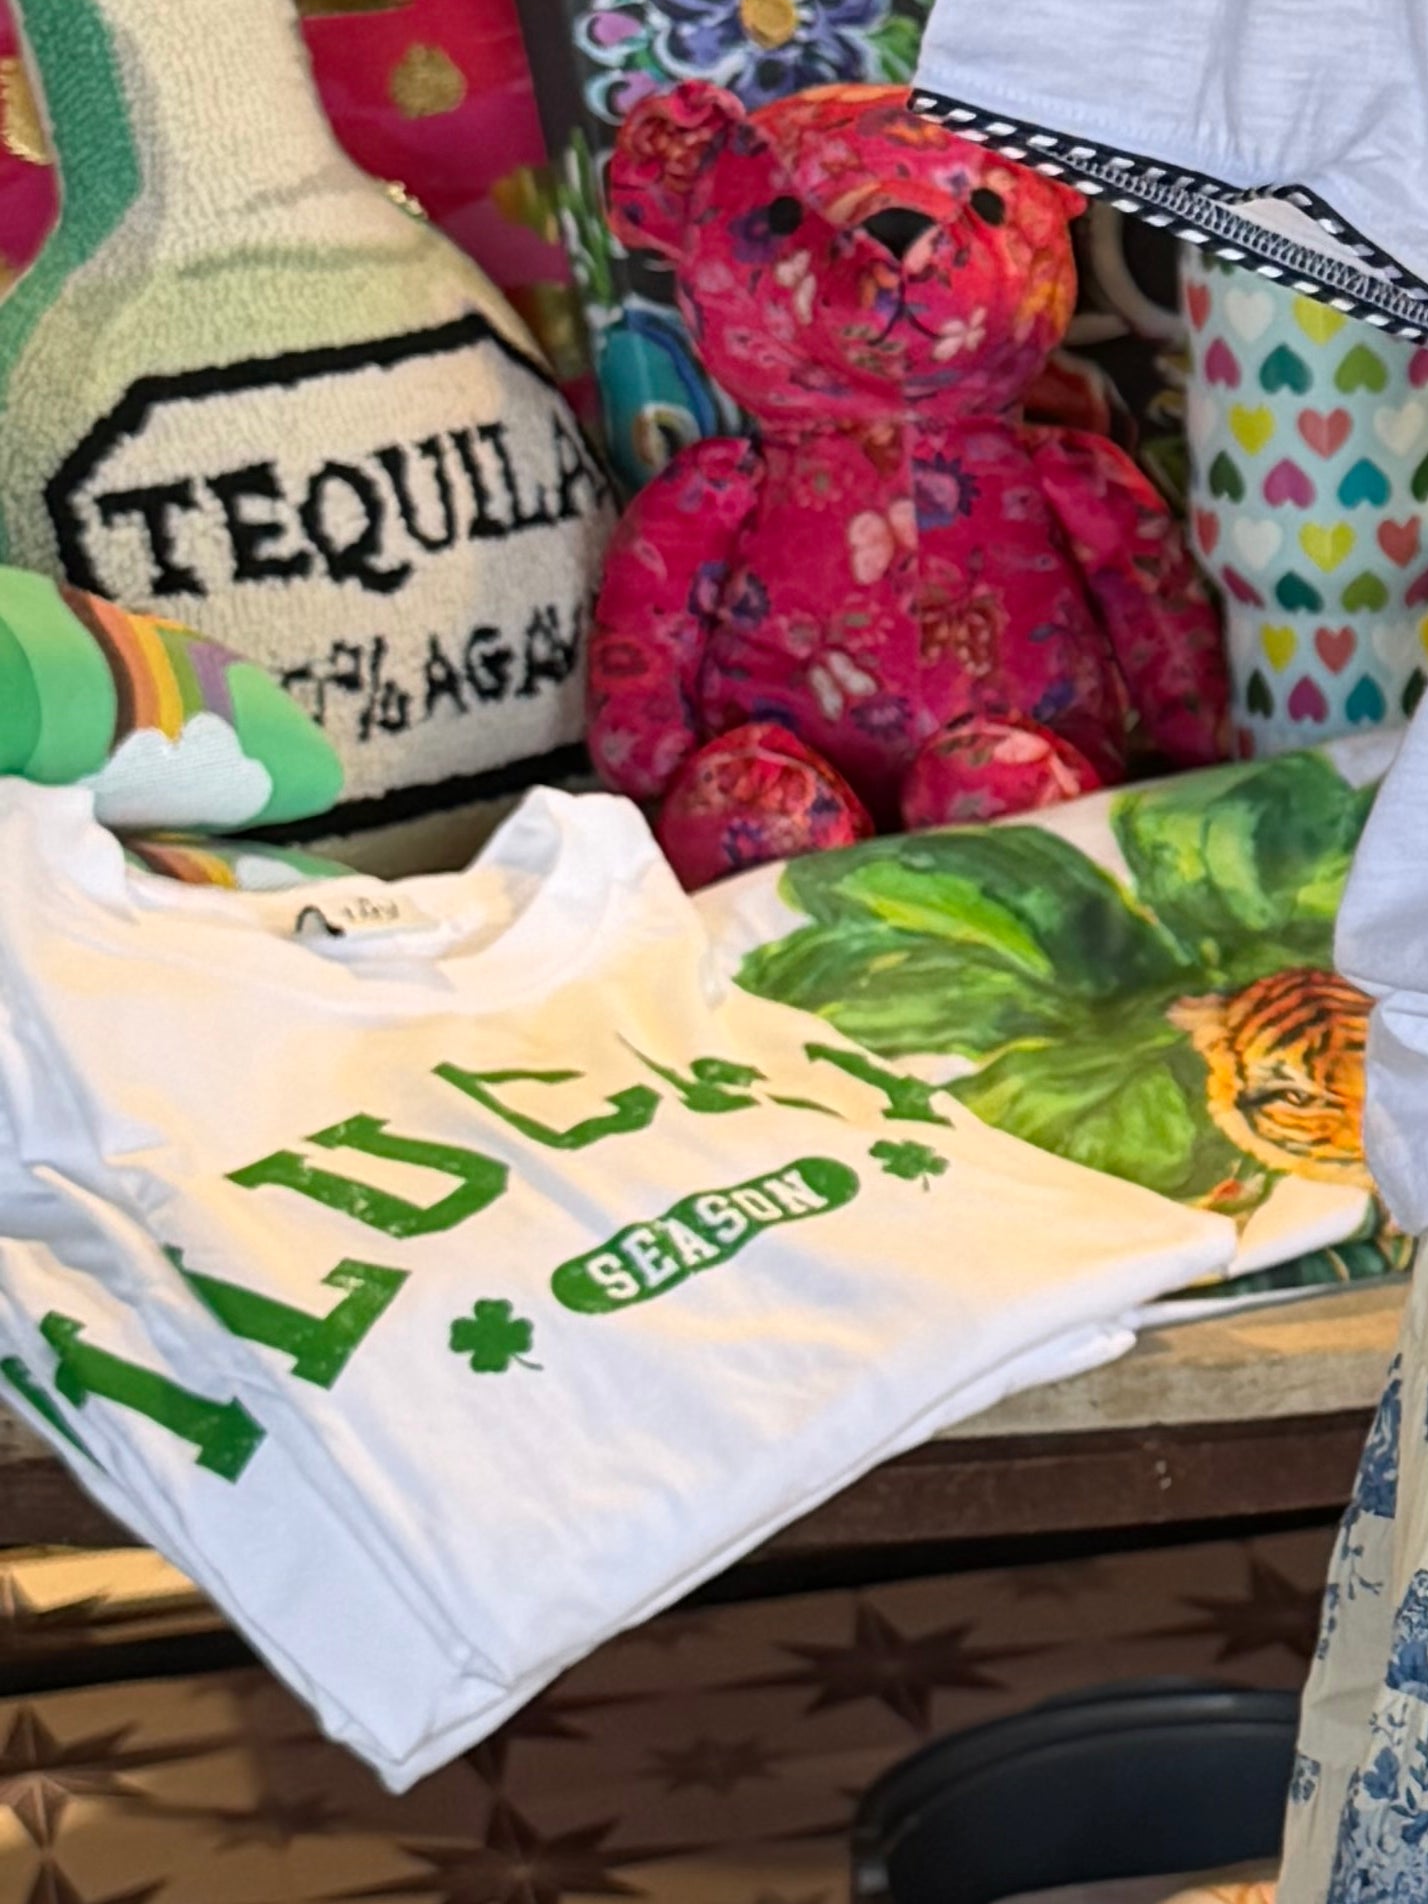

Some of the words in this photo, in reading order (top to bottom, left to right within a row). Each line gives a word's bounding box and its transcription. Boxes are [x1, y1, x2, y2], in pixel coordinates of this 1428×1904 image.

[94, 414, 606, 598] TEQUILA
[424, 603, 582, 718] AGAV
[585, 1168, 830, 1301] SEASON
